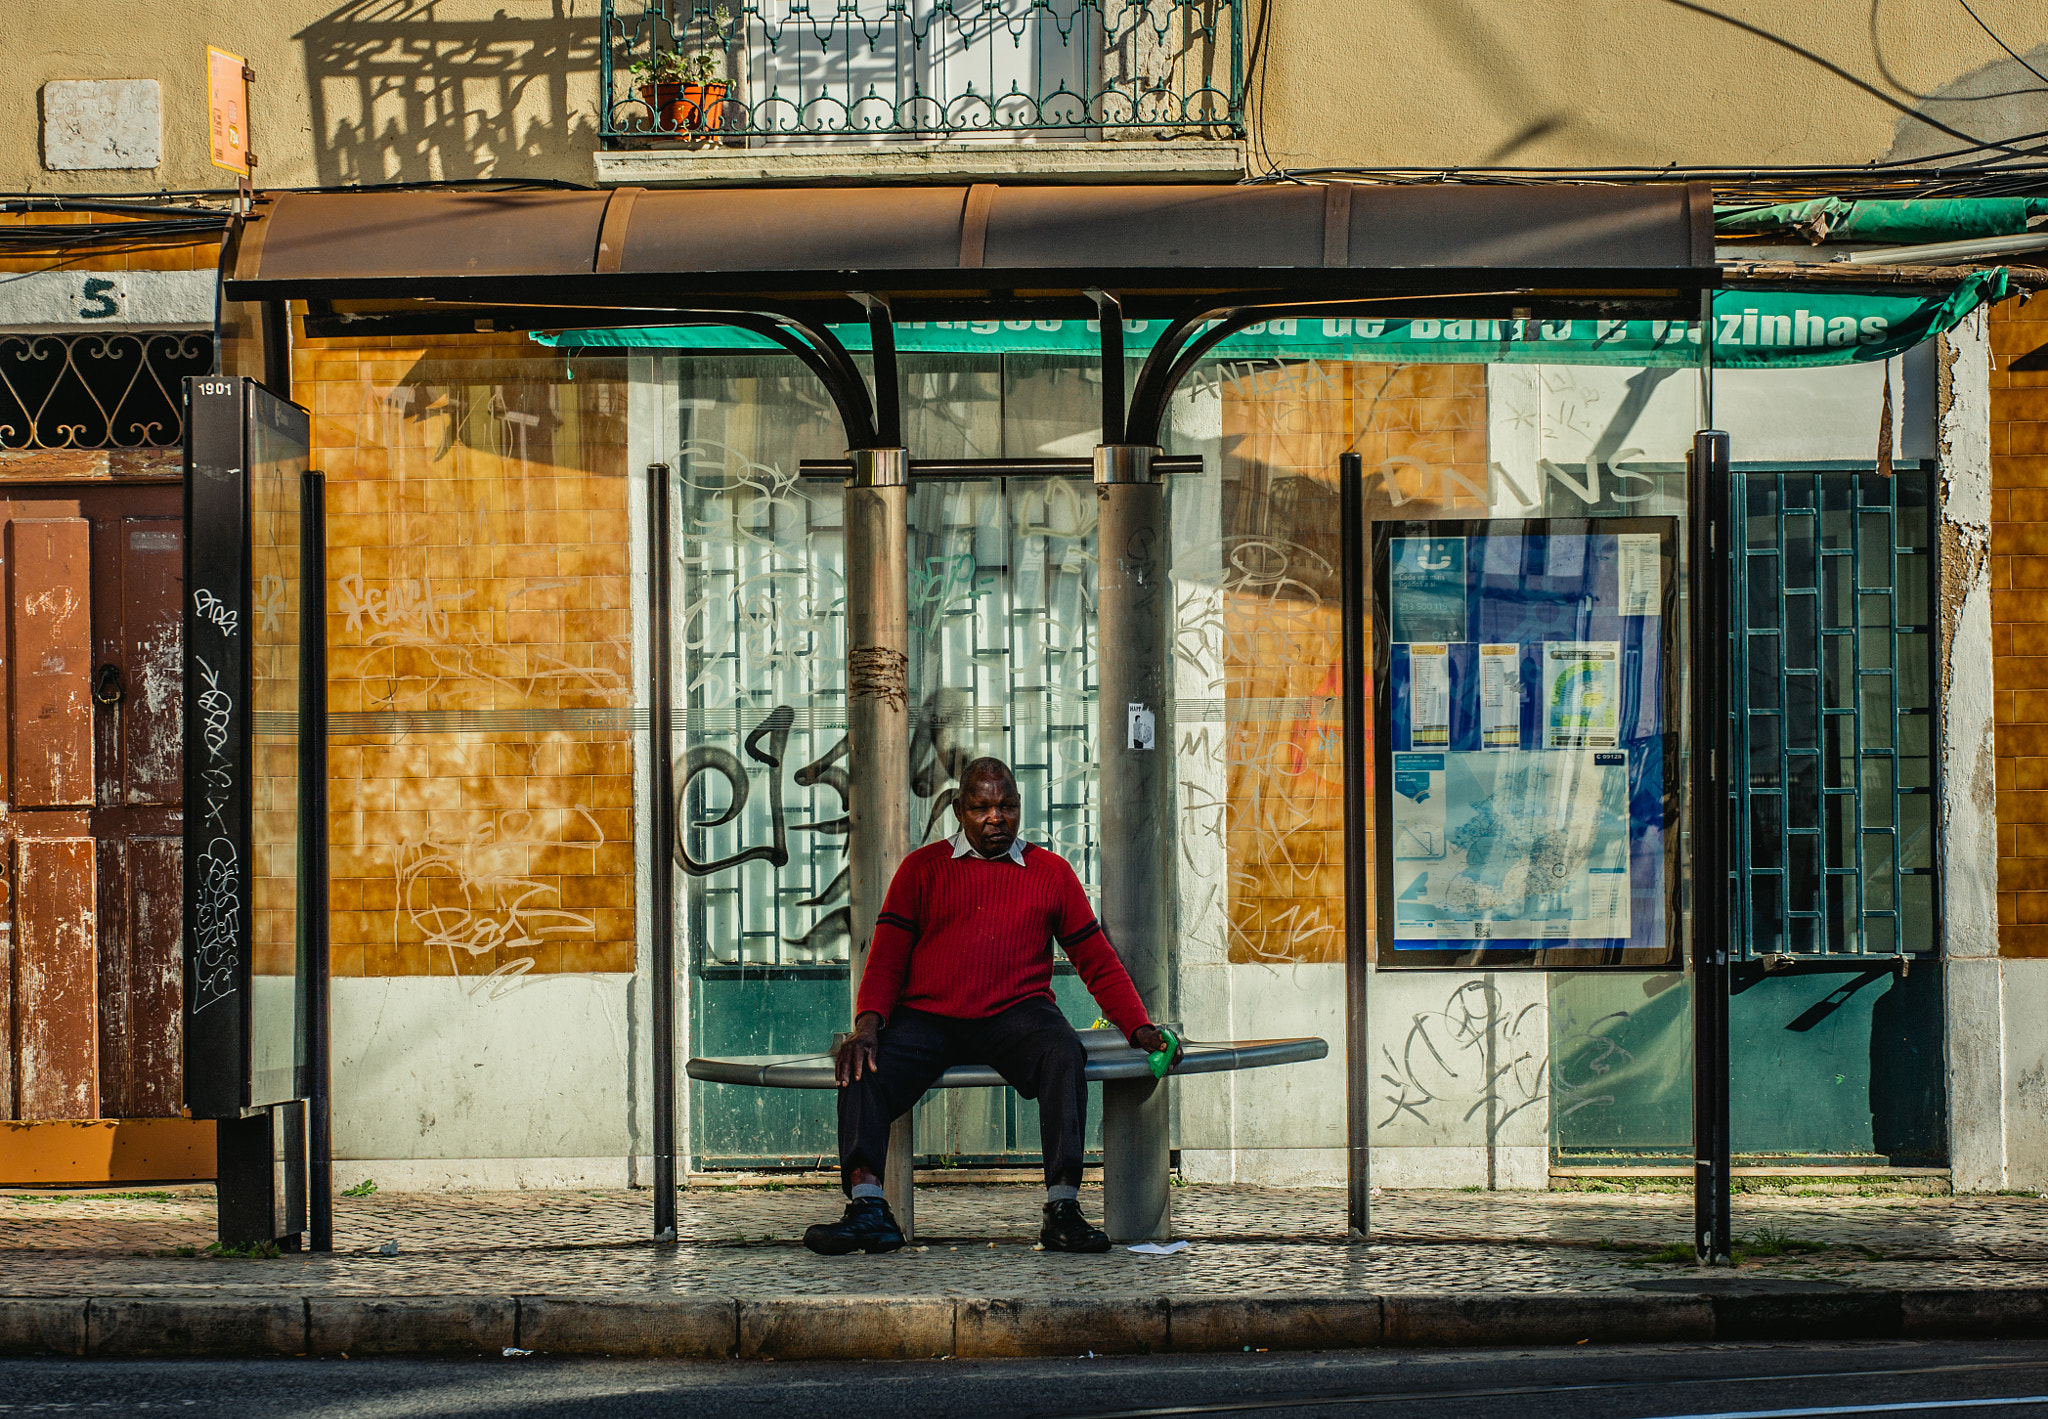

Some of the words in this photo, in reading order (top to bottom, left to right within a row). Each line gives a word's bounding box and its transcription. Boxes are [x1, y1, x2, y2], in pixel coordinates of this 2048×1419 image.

[80, 278, 118, 318] 5
[1410, 319, 1572, 342] Bano
[198, 382, 232, 396] 1901
[1399, 602, 1414, 611] 213
[1416, 602, 1433, 611] 500
